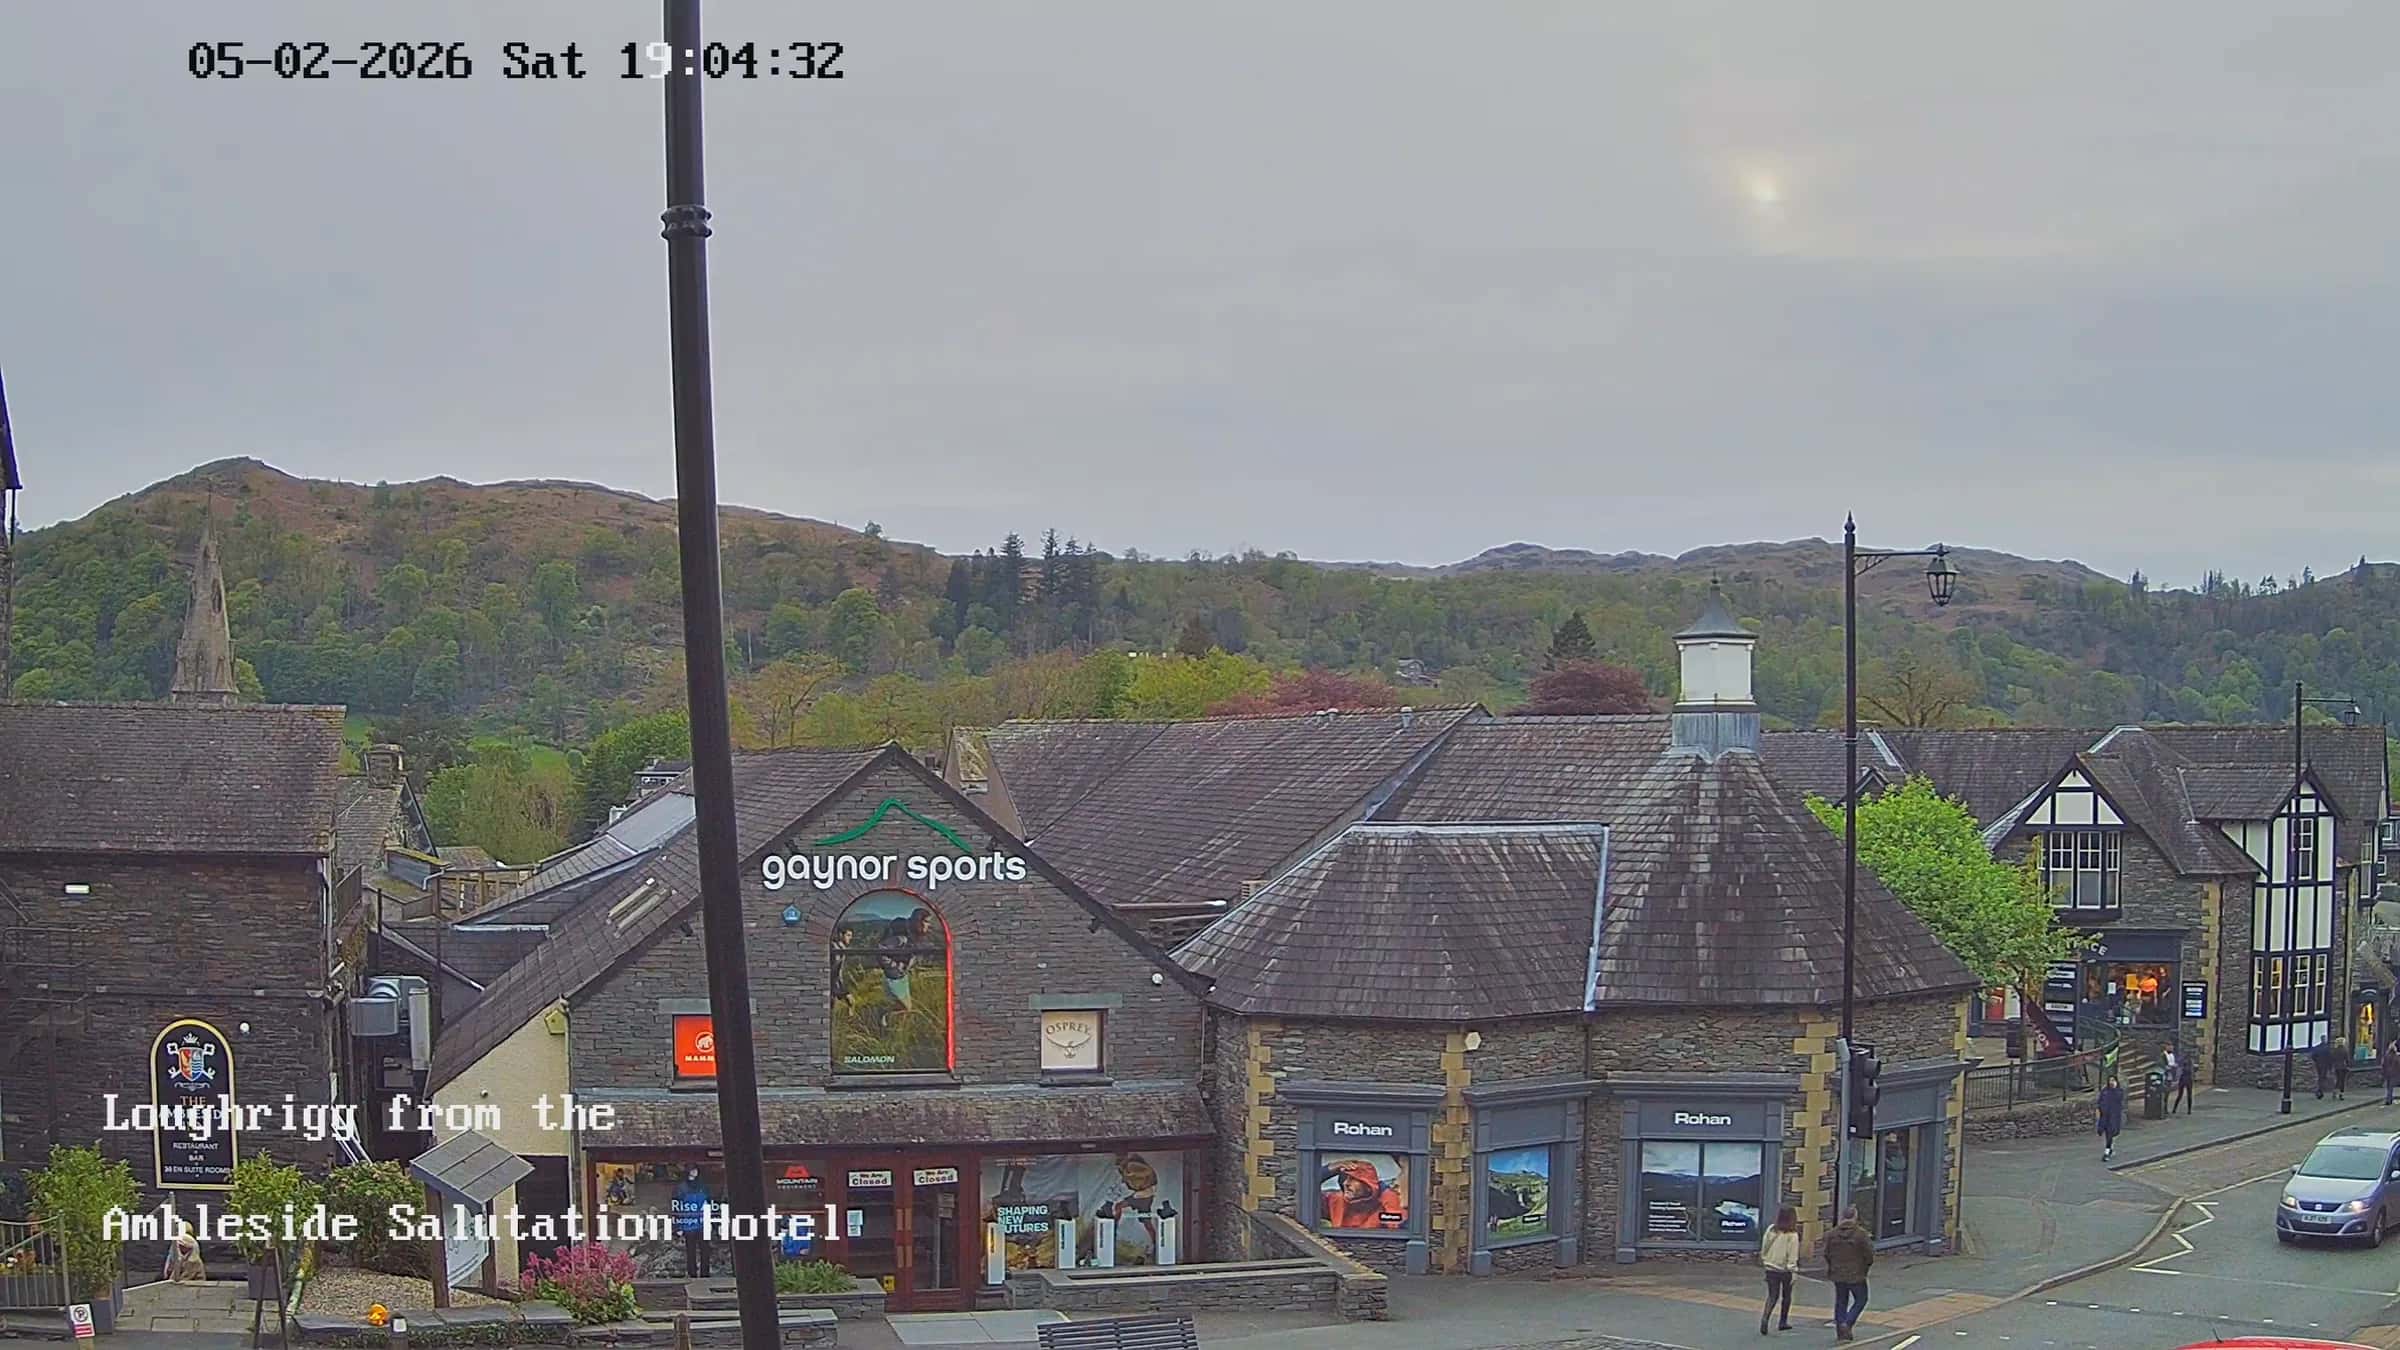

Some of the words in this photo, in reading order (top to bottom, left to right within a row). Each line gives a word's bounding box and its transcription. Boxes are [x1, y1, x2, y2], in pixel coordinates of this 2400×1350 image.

[762, 854, 898, 890] gaynor
[907, 851, 1027, 890] sports
[1046, 1022, 1090, 1035] OSPREY
[844, 1055, 895, 1064] SALOMON
[180, 1095, 207, 1106] THE
[1674, 1112, 1732, 1125] Rohan
[1333, 1122, 1393, 1136] Rohan
[852, 1178, 888, 1186] Closed
[918, 1175, 954, 1184] Closed
[671, 1199, 698, 1212] Rise
[997, 1205, 1049, 1217] SHAPING
[997, 1215, 1024, 1225] NEW
